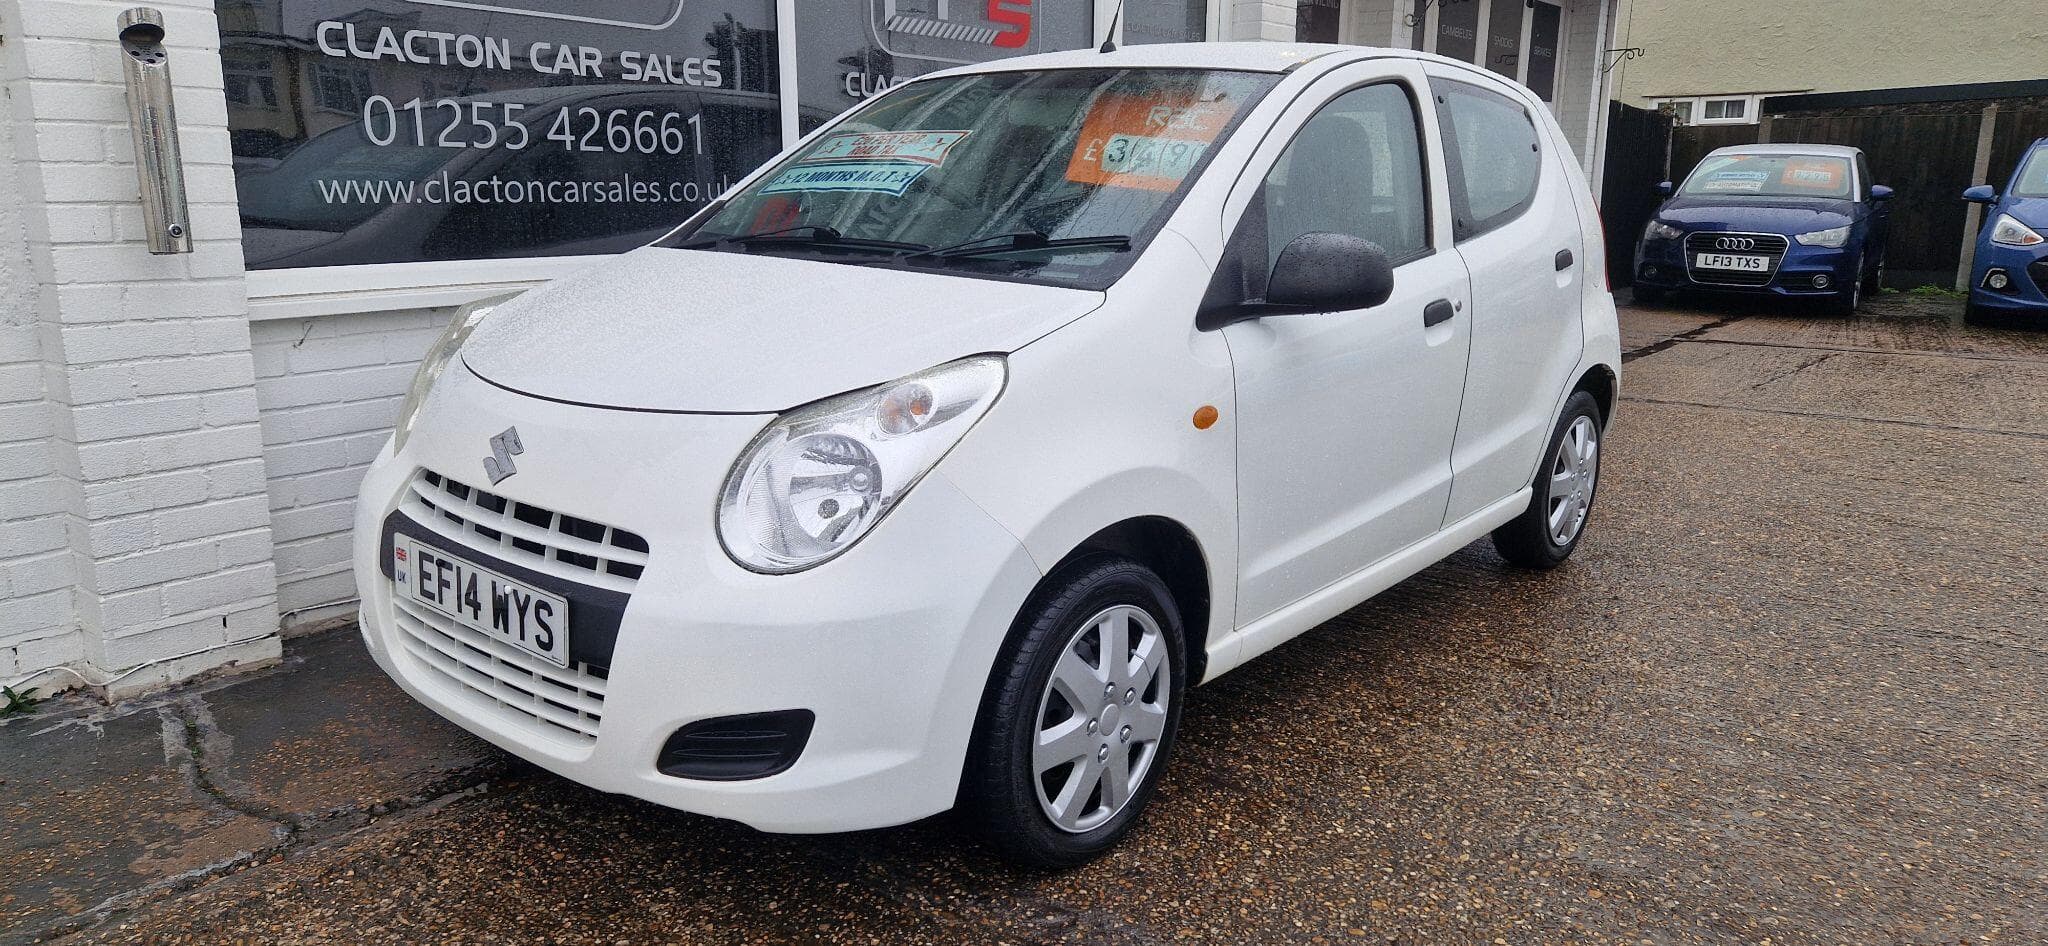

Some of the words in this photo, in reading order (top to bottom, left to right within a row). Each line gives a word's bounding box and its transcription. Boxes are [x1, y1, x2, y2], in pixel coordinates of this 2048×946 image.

[1441, 24, 1472, 40] CAMBELTS
[317, 21, 511, 70] CLACTON
[530, 42, 603, 78] CAR
[620, 51, 722, 87] SALES
[363, 95, 529, 150] 01255
[547, 106, 702, 155] 426661
[318, 170, 736, 204] www.clactoncarsales.co.uk
[790, 173, 804, 184] 12
[804, 170, 858, 183] MONTHS
[1704, 255, 1732, 267] LF13
[1736, 256, 1761, 269] TXS
[397, 569, 406, 584] UK
[418, 550, 482, 621] EF14
[491, 579, 554, 652] WYS
